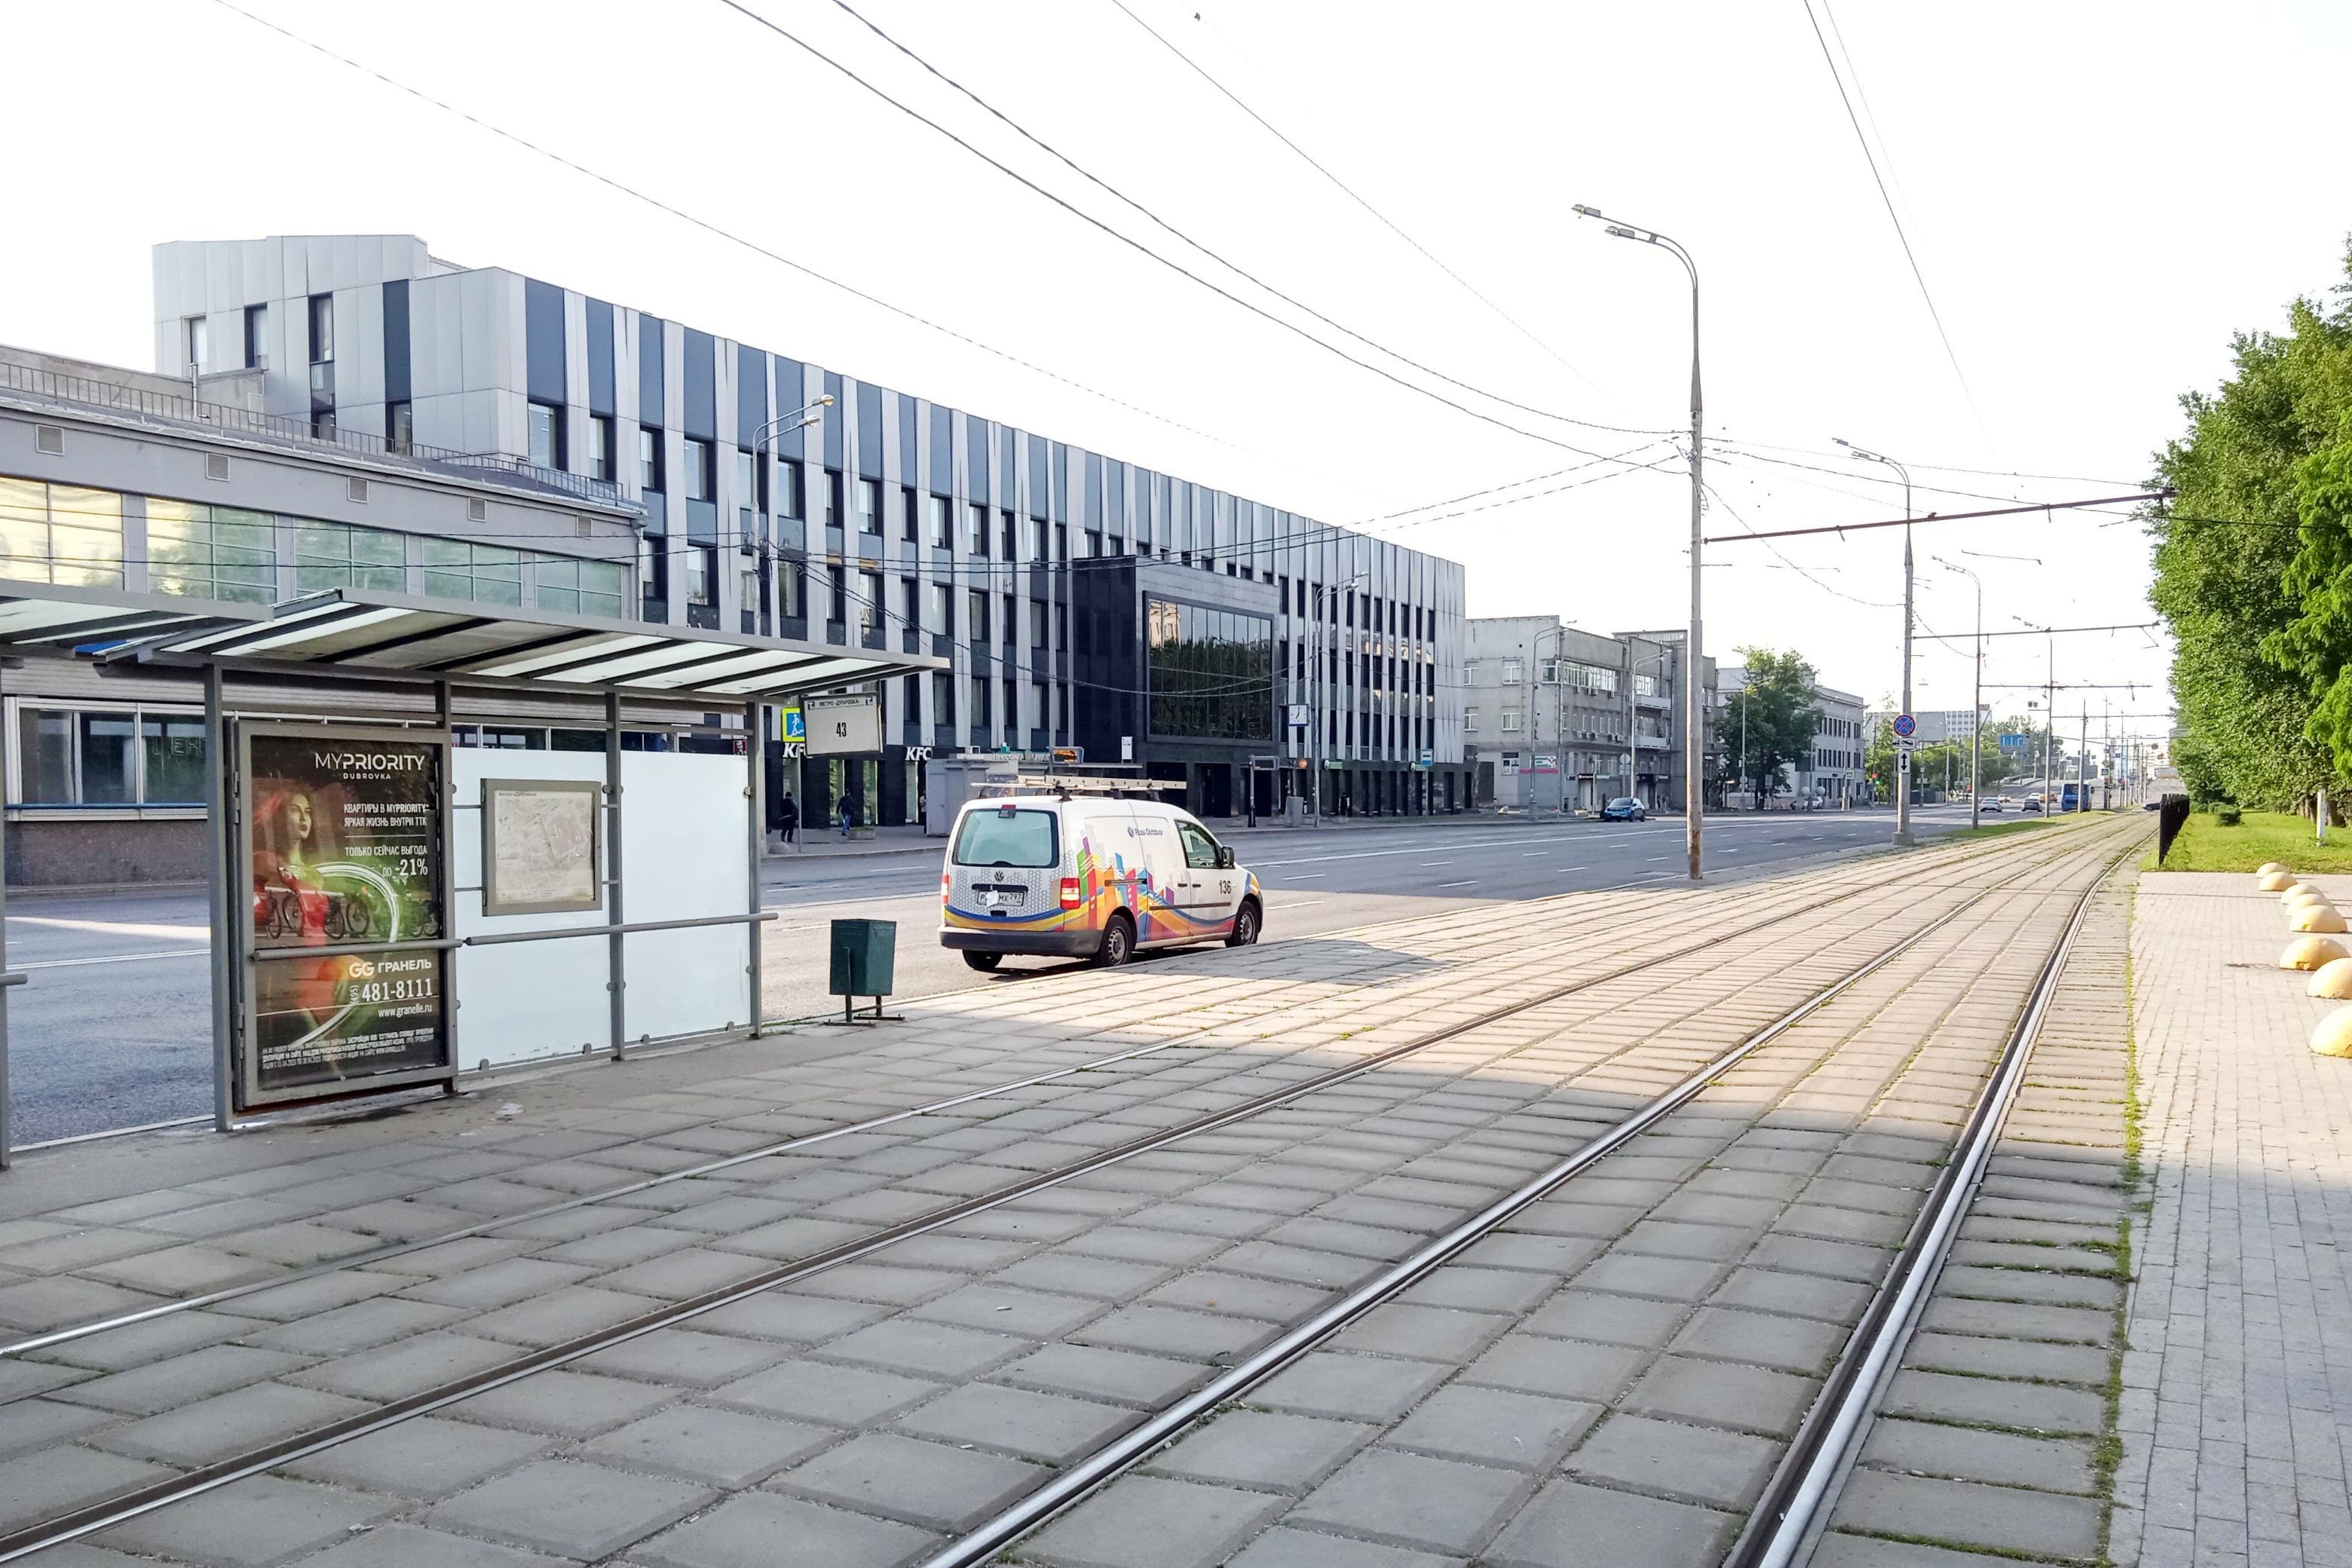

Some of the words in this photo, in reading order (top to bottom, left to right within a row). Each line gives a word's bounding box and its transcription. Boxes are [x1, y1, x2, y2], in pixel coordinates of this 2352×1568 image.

[836, 722, 847, 737] 43
[905, 746, 932, 761] KFC
[315, 753, 425, 770] MYPRIORITY
[344, 804, 378, 813] КВАРТИРЫ
[380, 804, 385, 813] В
[344, 817, 365, 827] ЯРКАЯ
[366, 817, 389, 827] ЖИЗНЬ
[390, 816, 414, 827] ВНУТРИ
[415, 816, 427, 826] ТТК
[345, 847, 372, 856] ТОЛЬКО
[373, 845, 400, 856] СЕЙЧАС
[400, 845, 427, 855] ВЫГОДА
[395, 859, 428, 876] -21%
[1219, 880, 1231, 894] 136
[378, 959, 432, 973] ГРАНЕЛЬ
[362, 978, 433, 1002] 481-8111
[378, 1003, 433, 1018] www.granelle.ru
